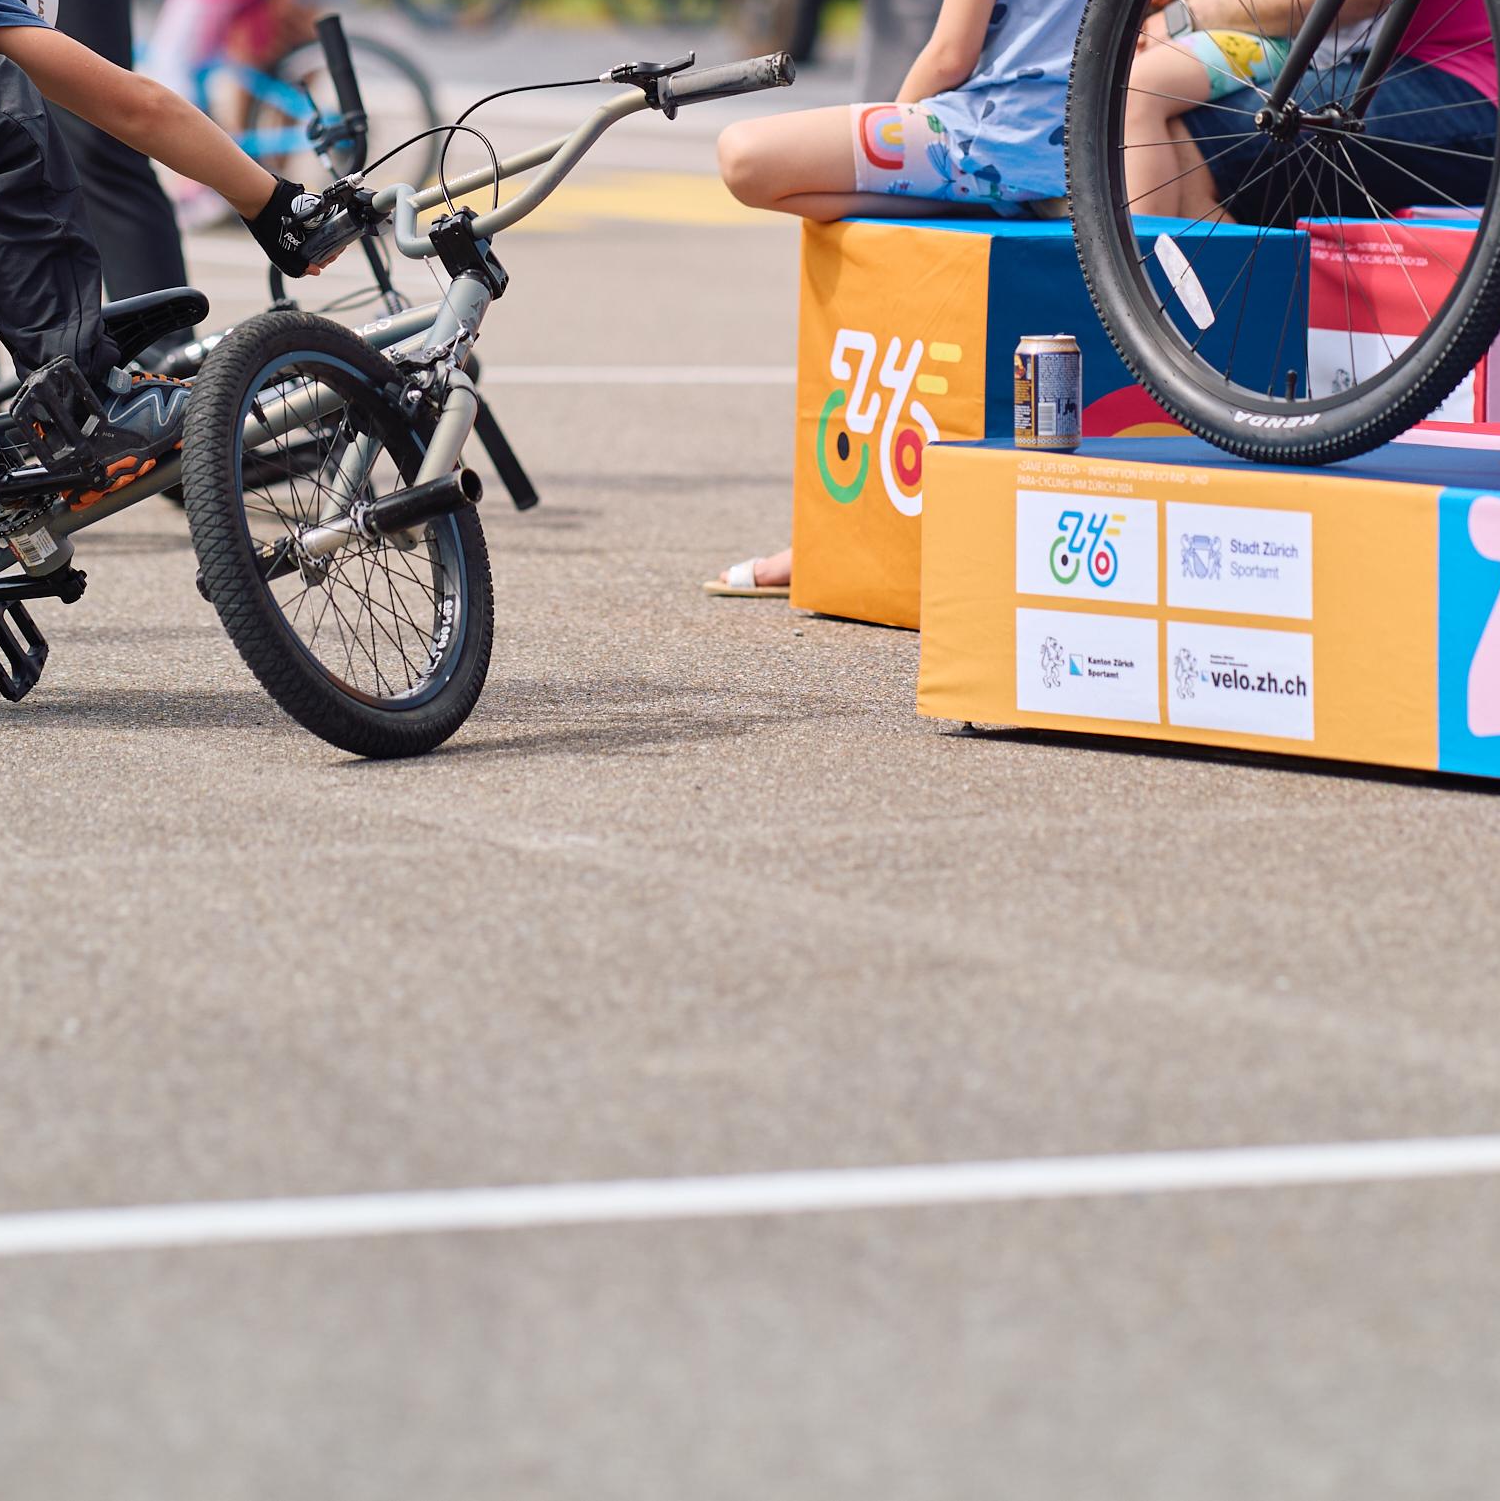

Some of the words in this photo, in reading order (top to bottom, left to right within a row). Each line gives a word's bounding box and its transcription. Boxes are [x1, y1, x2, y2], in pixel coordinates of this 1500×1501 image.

[1233, 410, 1321, 429] KENDA
[1230, 539, 1260, 555] Stadt
[1263, 541, 1299, 558] Zürich
[1230, 561, 1279, 580] Sportamt
[1087, 656, 1111, 667] Kanton
[1113, 658, 1135, 668] Zürich
[1087, 668, 1119, 679] Sportamt
[1211, 668, 1307, 697] velo.zh.ch
